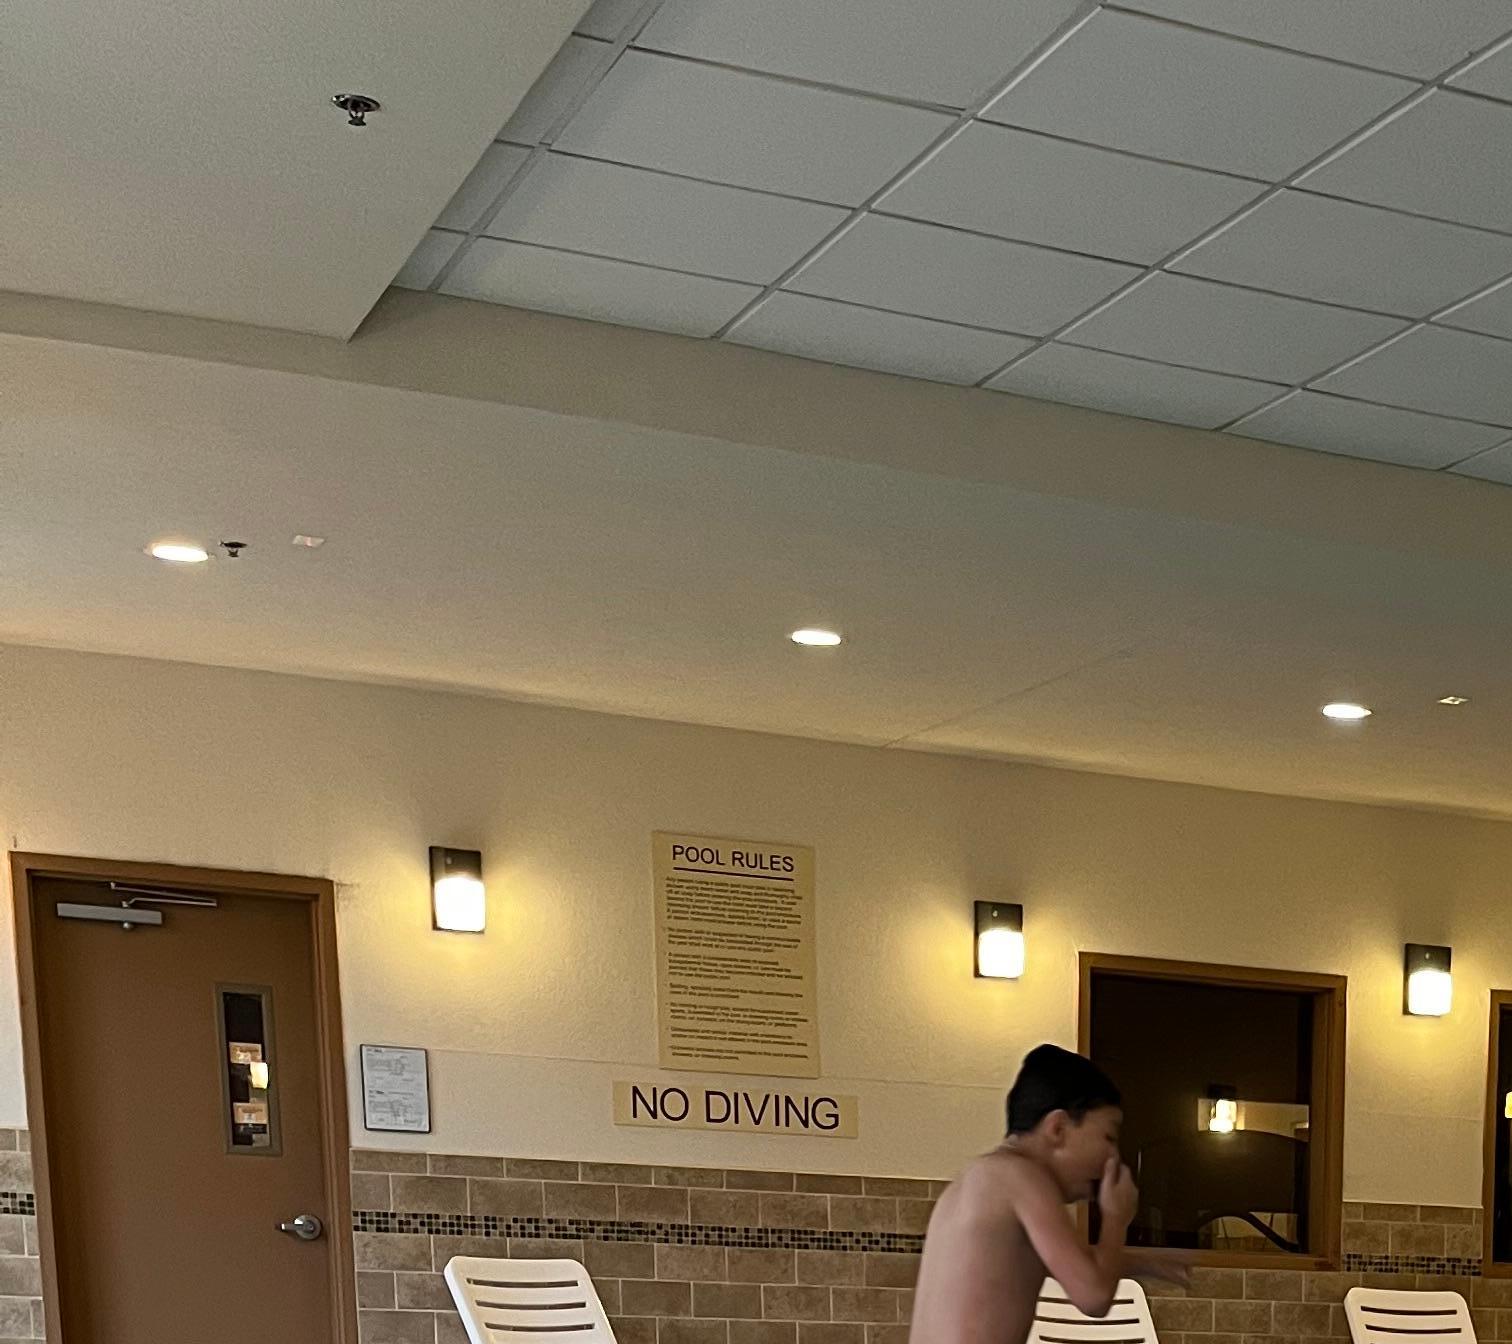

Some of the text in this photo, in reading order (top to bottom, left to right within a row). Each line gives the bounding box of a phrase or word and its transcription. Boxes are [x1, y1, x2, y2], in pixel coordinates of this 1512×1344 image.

[671, 845, 794, 872] POOL RULES
[631, 1085, 841, 1130] NO DIVING
